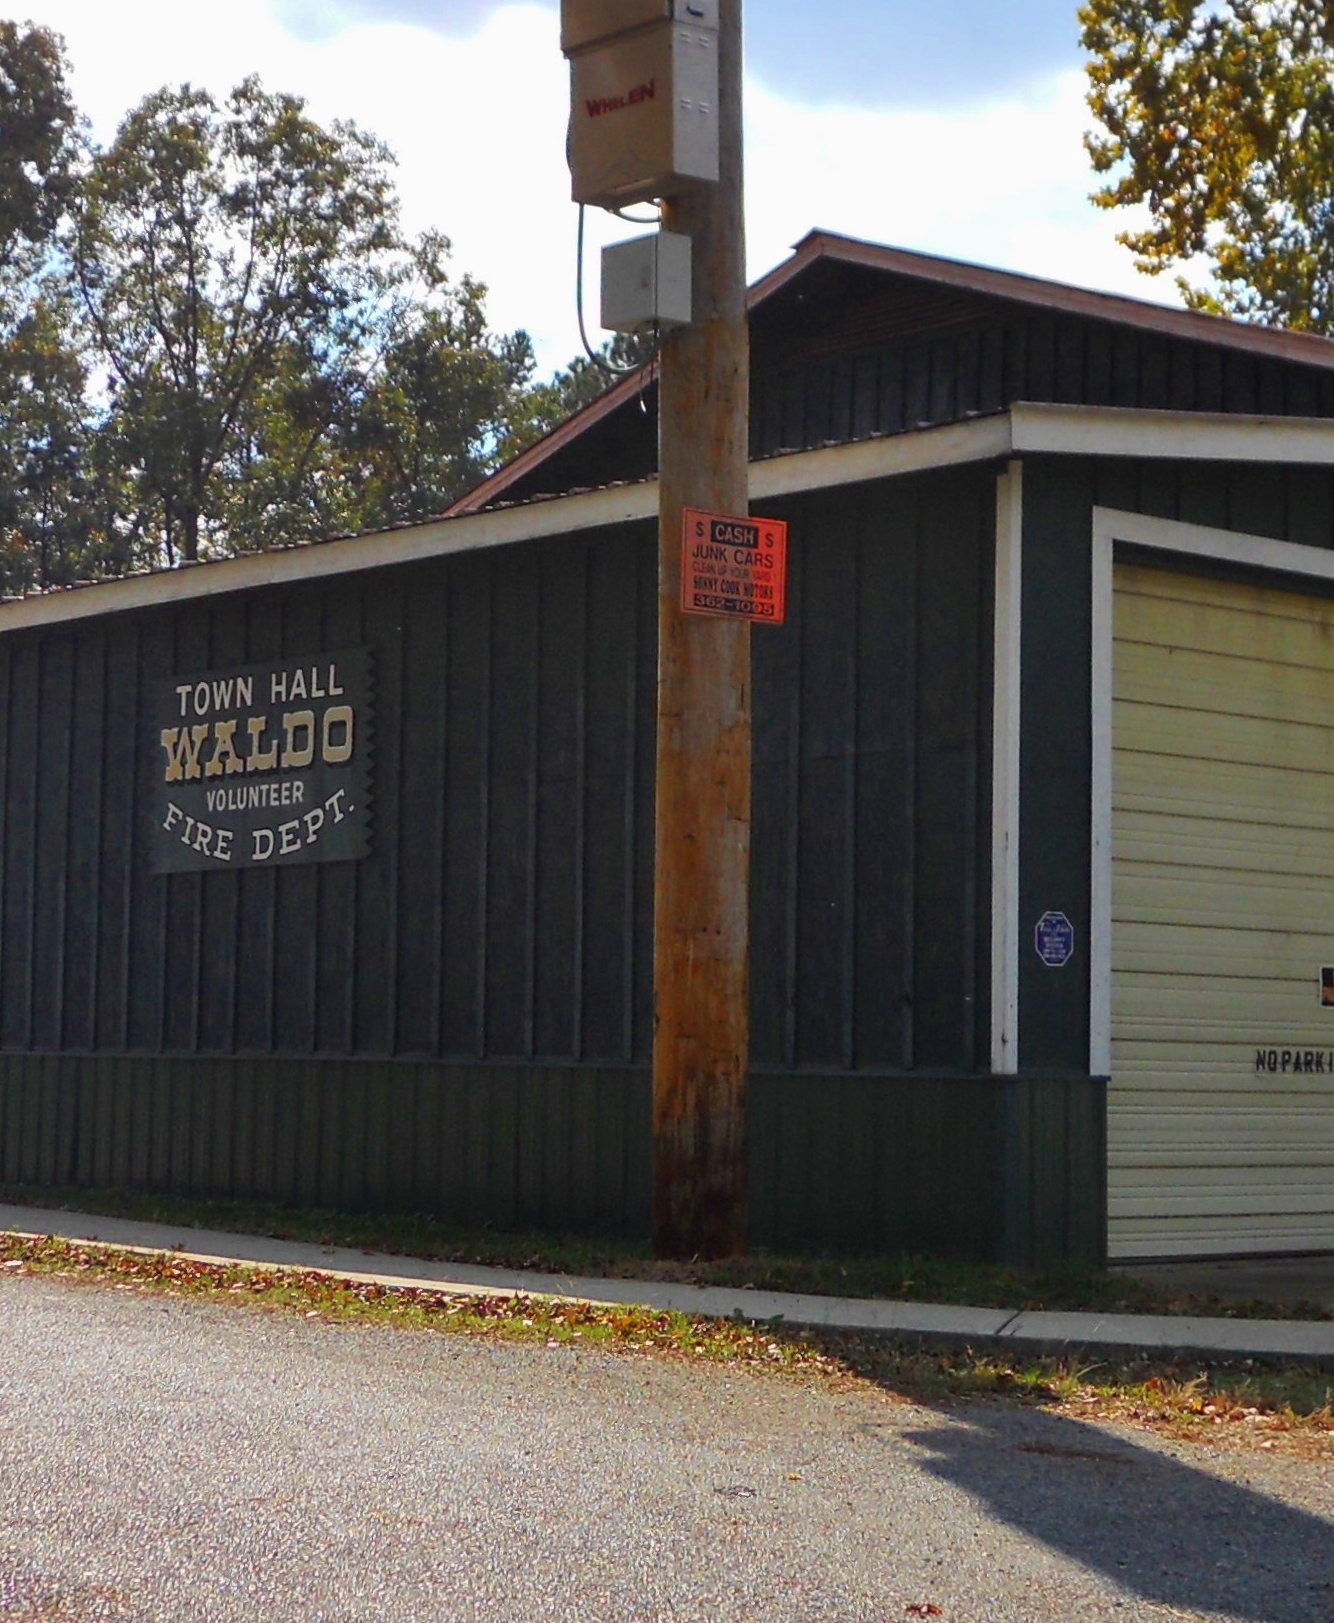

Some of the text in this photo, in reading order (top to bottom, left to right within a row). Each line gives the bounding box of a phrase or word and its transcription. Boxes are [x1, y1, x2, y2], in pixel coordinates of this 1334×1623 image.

[716, 524, 754, 545] CASH
[692, 544, 773, 569] JUNK CARS
[696, 595, 773, 614] 362-1095
[176, 664, 344, 717] TOWN HALL
[161, 705, 354, 782] WALDO
[207, 781, 305, 812] VOLUNTEER
[163, 789, 356, 862] FIRE DEPT.
